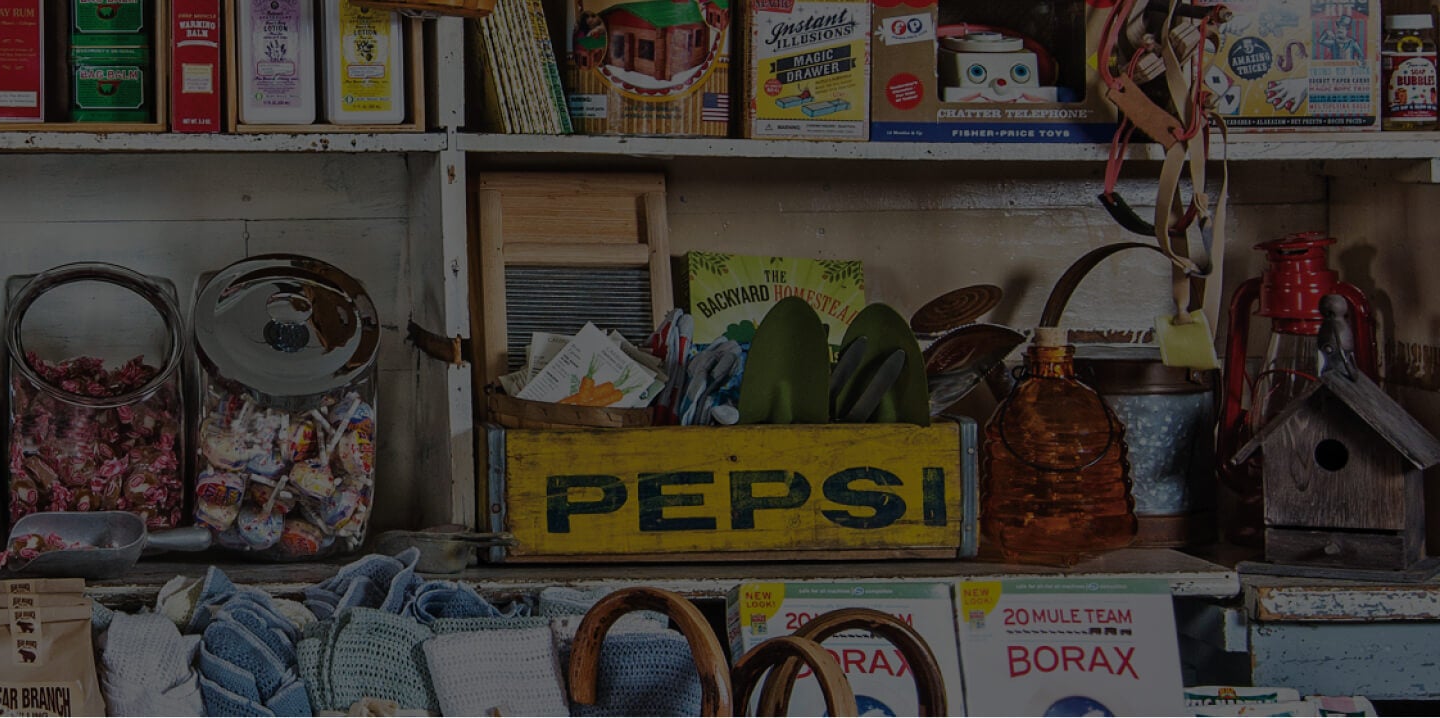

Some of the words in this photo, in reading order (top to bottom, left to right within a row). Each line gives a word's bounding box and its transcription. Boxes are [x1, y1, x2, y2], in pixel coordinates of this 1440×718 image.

[13, 7, 35, 18] RUM
[179, 20, 216, 30] WARMING
[765, 8, 847, 45] Instant
[186, 29, 208, 38] BALM
[777, 25, 852, 49] ILLUSIONS
[1243, 38, 1255, 53] 5
[793, 49, 834, 67] MAGIC
[1232, 51, 1271, 67] AMAZING
[786, 62, 840, 82] DRAWER
[1237, 63, 1268, 75] TRICKS
[1397, 75, 1435, 86] BUBBLES
[938, 109, 1002, 118] CHATTER
[1005, 108, 1088, 118] TELEPHONE
[1039, 129, 1070, 137] TOYS
[764, 270, 787, 283] THE
[697, 284, 770, 318] BACKYARD
[547, 466, 947, 533] PEPSI
[746, 592, 772, 600] NEW
[964, 589, 989, 597] NEW
[964, 597, 992, 605] LOOK!
[1003, 608, 1029, 626] 20
[1032, 608, 1081, 624] MULE
[1082, 608, 1133, 624] TEAM
[1007, 645, 1140, 680] BORAX
[22, 686, 71, 717] BRANCH
